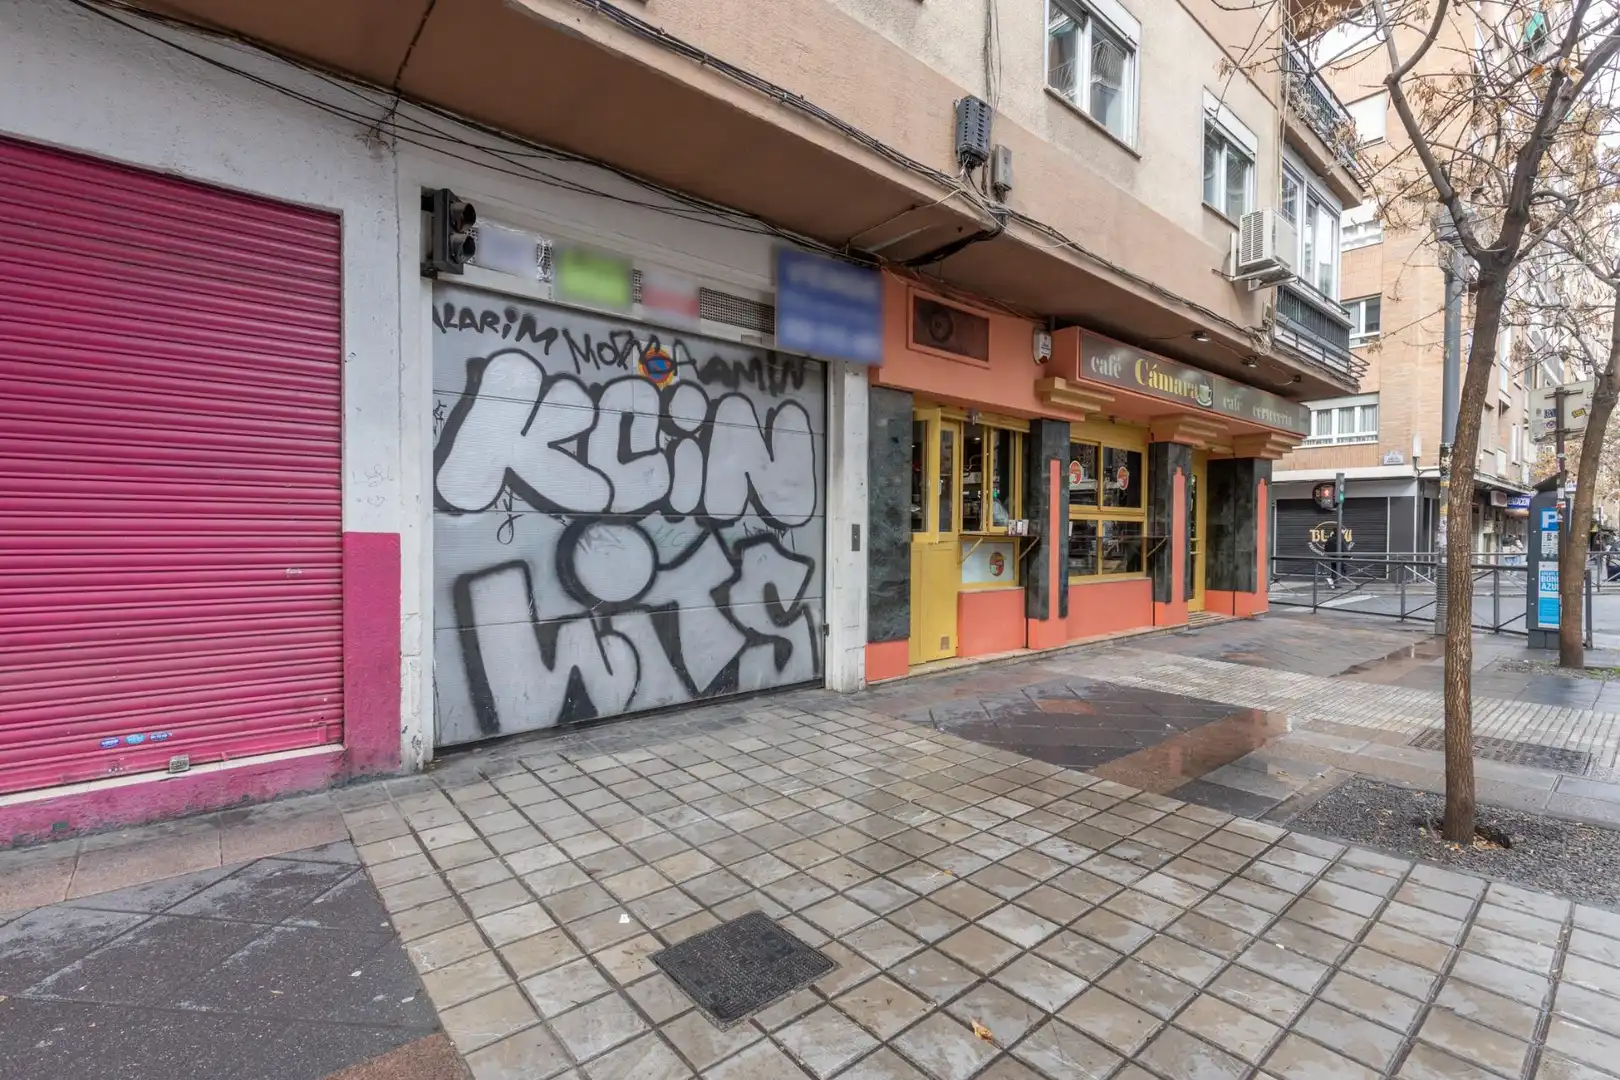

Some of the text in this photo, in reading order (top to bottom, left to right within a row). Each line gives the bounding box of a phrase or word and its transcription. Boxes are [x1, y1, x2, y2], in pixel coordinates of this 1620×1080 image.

[1091, 353, 1199, 399] café Cámara
[1542, 510, 1558, 529] P
